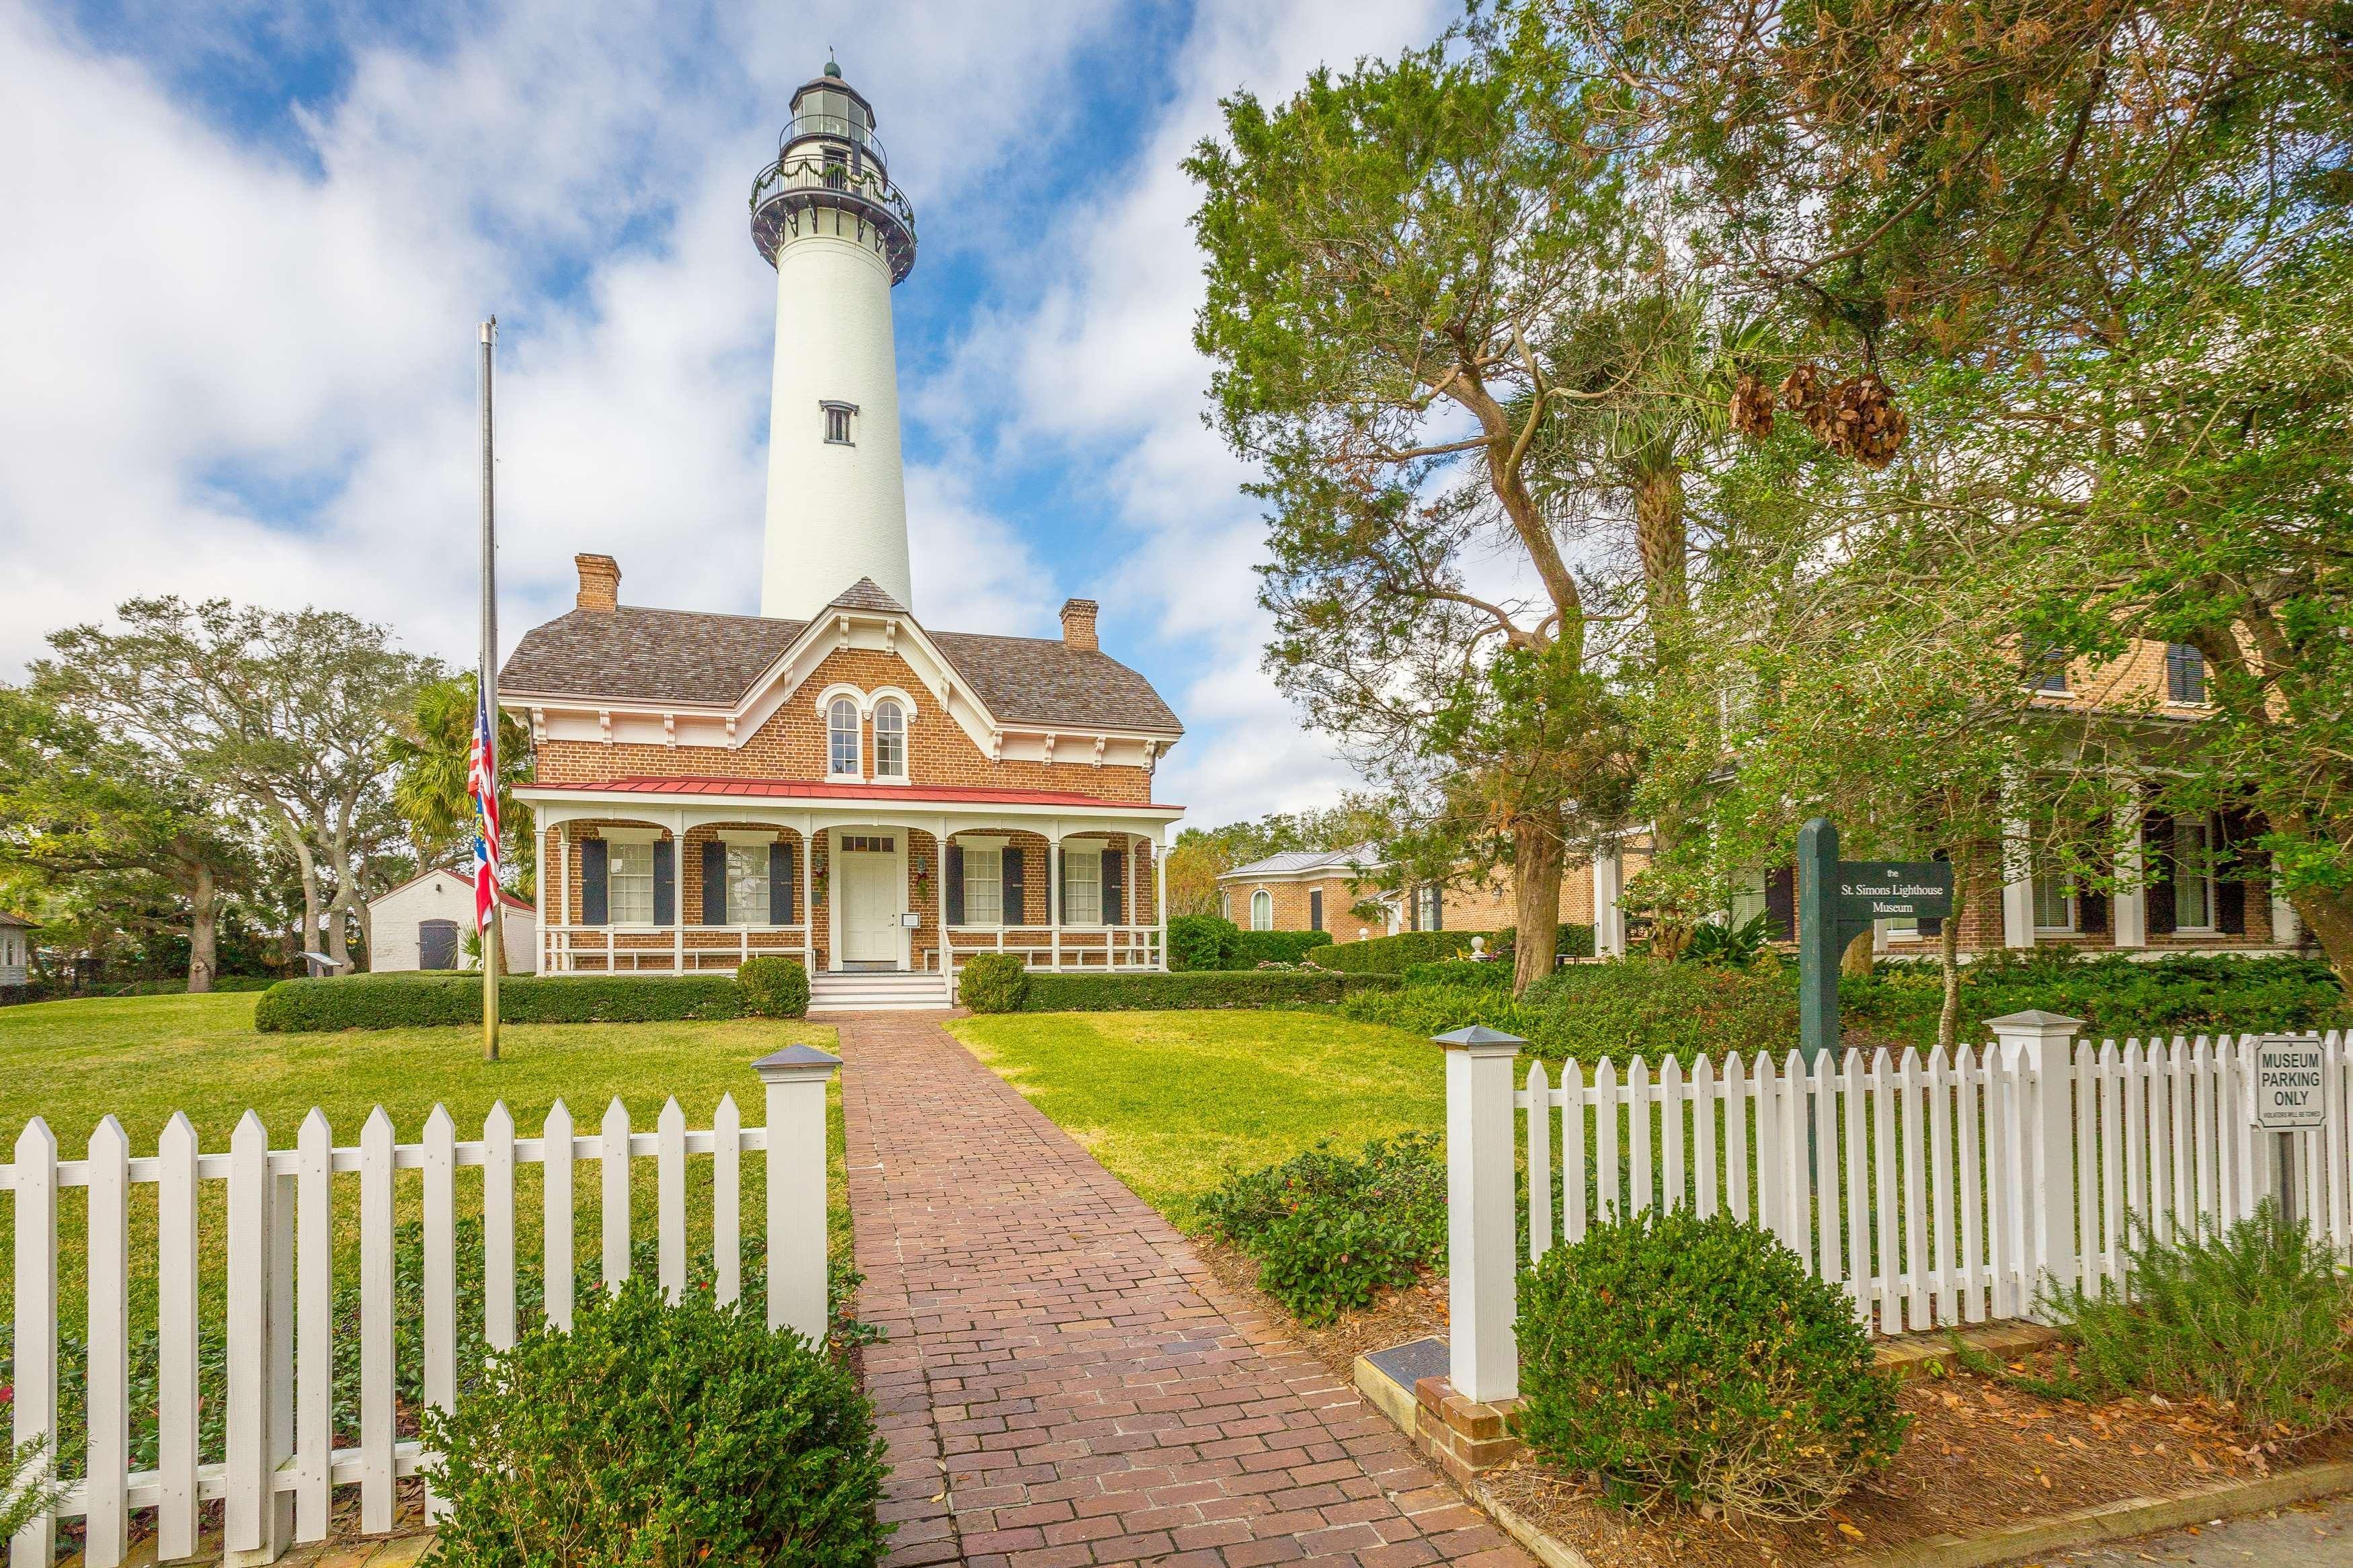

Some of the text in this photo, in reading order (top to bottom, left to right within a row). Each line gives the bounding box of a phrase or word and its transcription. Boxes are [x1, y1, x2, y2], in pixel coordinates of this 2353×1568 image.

[1887, 869, 1899, 877] the
[1841, 884, 1943, 898] St. Simons Lighthouse
[1873, 902, 1913, 913] Museum
[2262, 1053, 2319, 1068] MUSEUM
[2262, 1072, 2320, 1087] PARKING
[2274, 1091, 2309, 1106] ONLY
